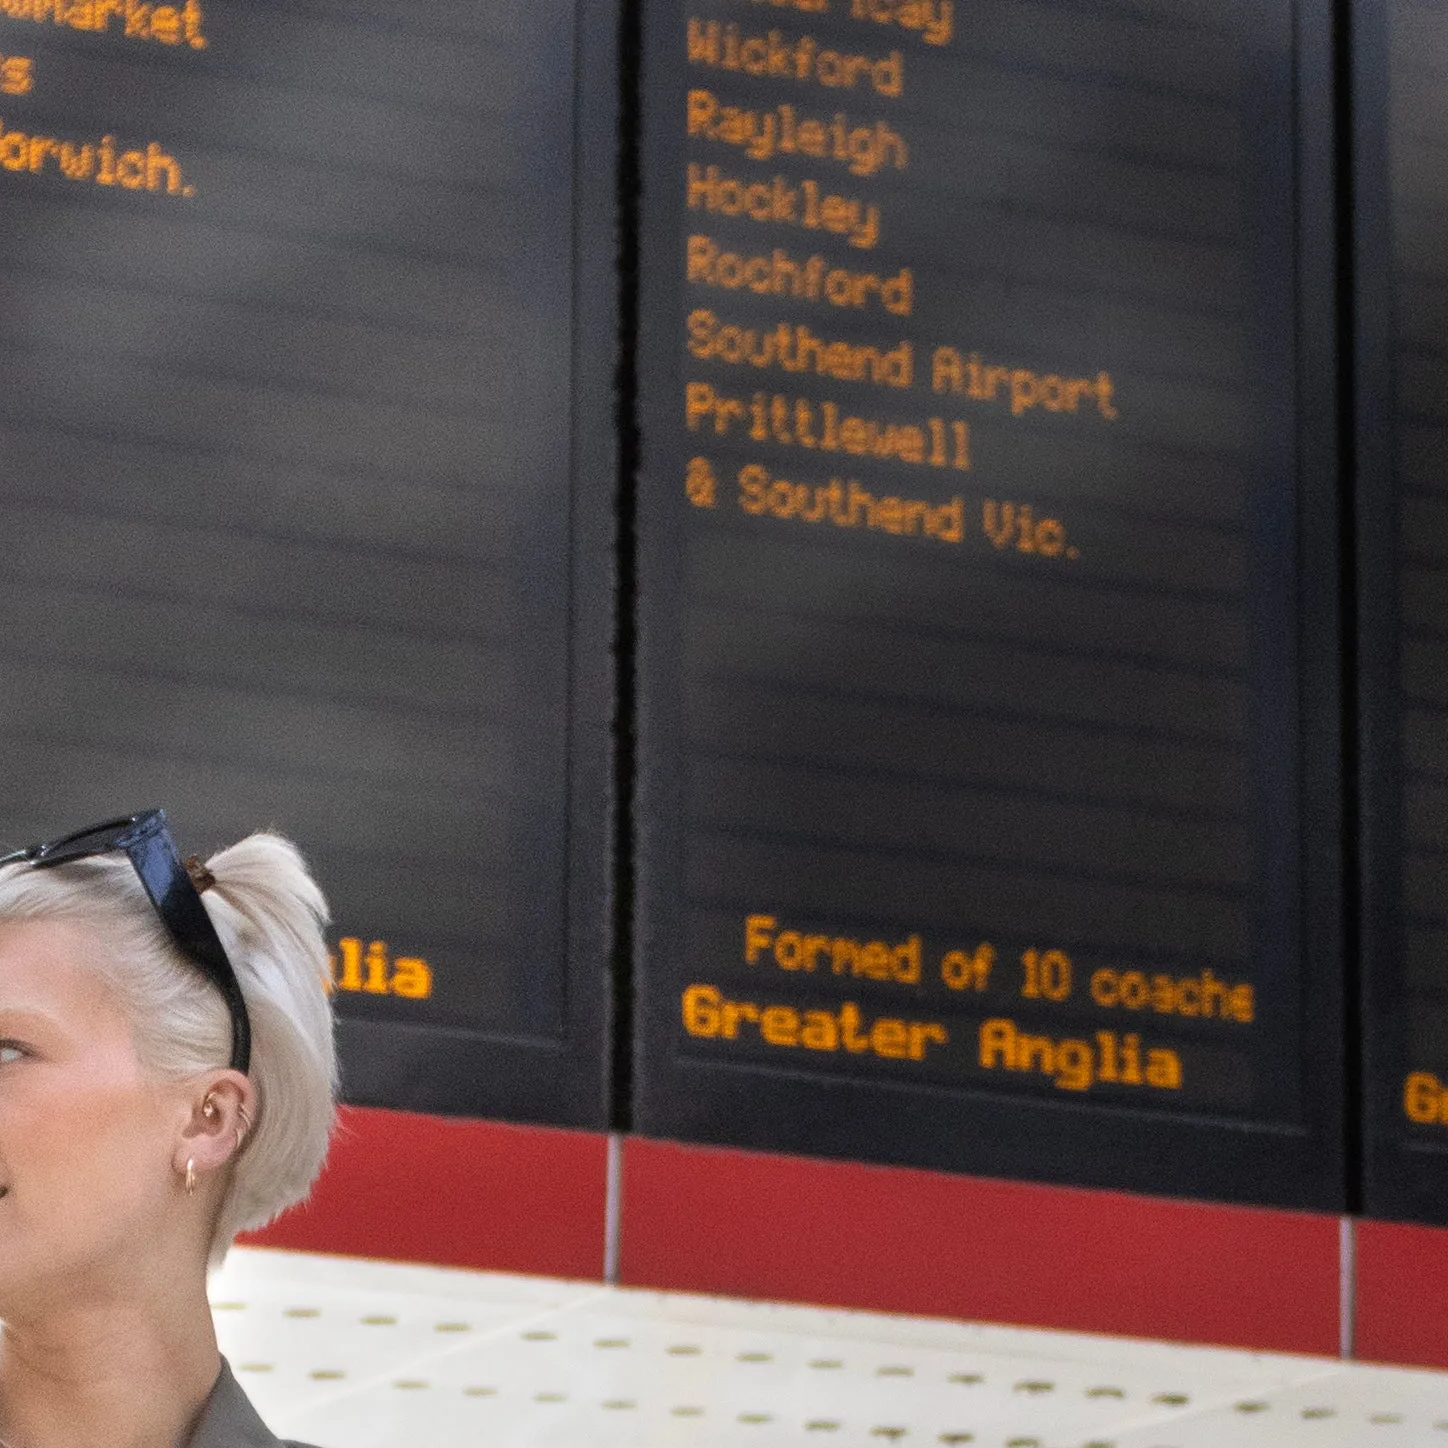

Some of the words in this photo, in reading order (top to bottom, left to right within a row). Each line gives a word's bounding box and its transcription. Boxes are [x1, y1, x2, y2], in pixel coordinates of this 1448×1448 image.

[687, 89, 906, 176] Rayleigh
[687, 163, 879, 249] Hockley
[687, 234, 912, 315] Rochford
[687, 309, 913, 388] Southend
[932, 346, 1115, 418] Airport
[686, 382, 970, 469] Prittlewell
[685, 457, 716, 508] &
[738, 464, 964, 543] Southend
[983, 500, 1079, 559] Vic.
[744, 914, 923, 985] Formed
[941, 943, 995, 991] of
[1021, 948, 1072, 1001] 10
[681, 984, 948, 1061] Greater
[979, 1018, 1184, 1092] Anglia
